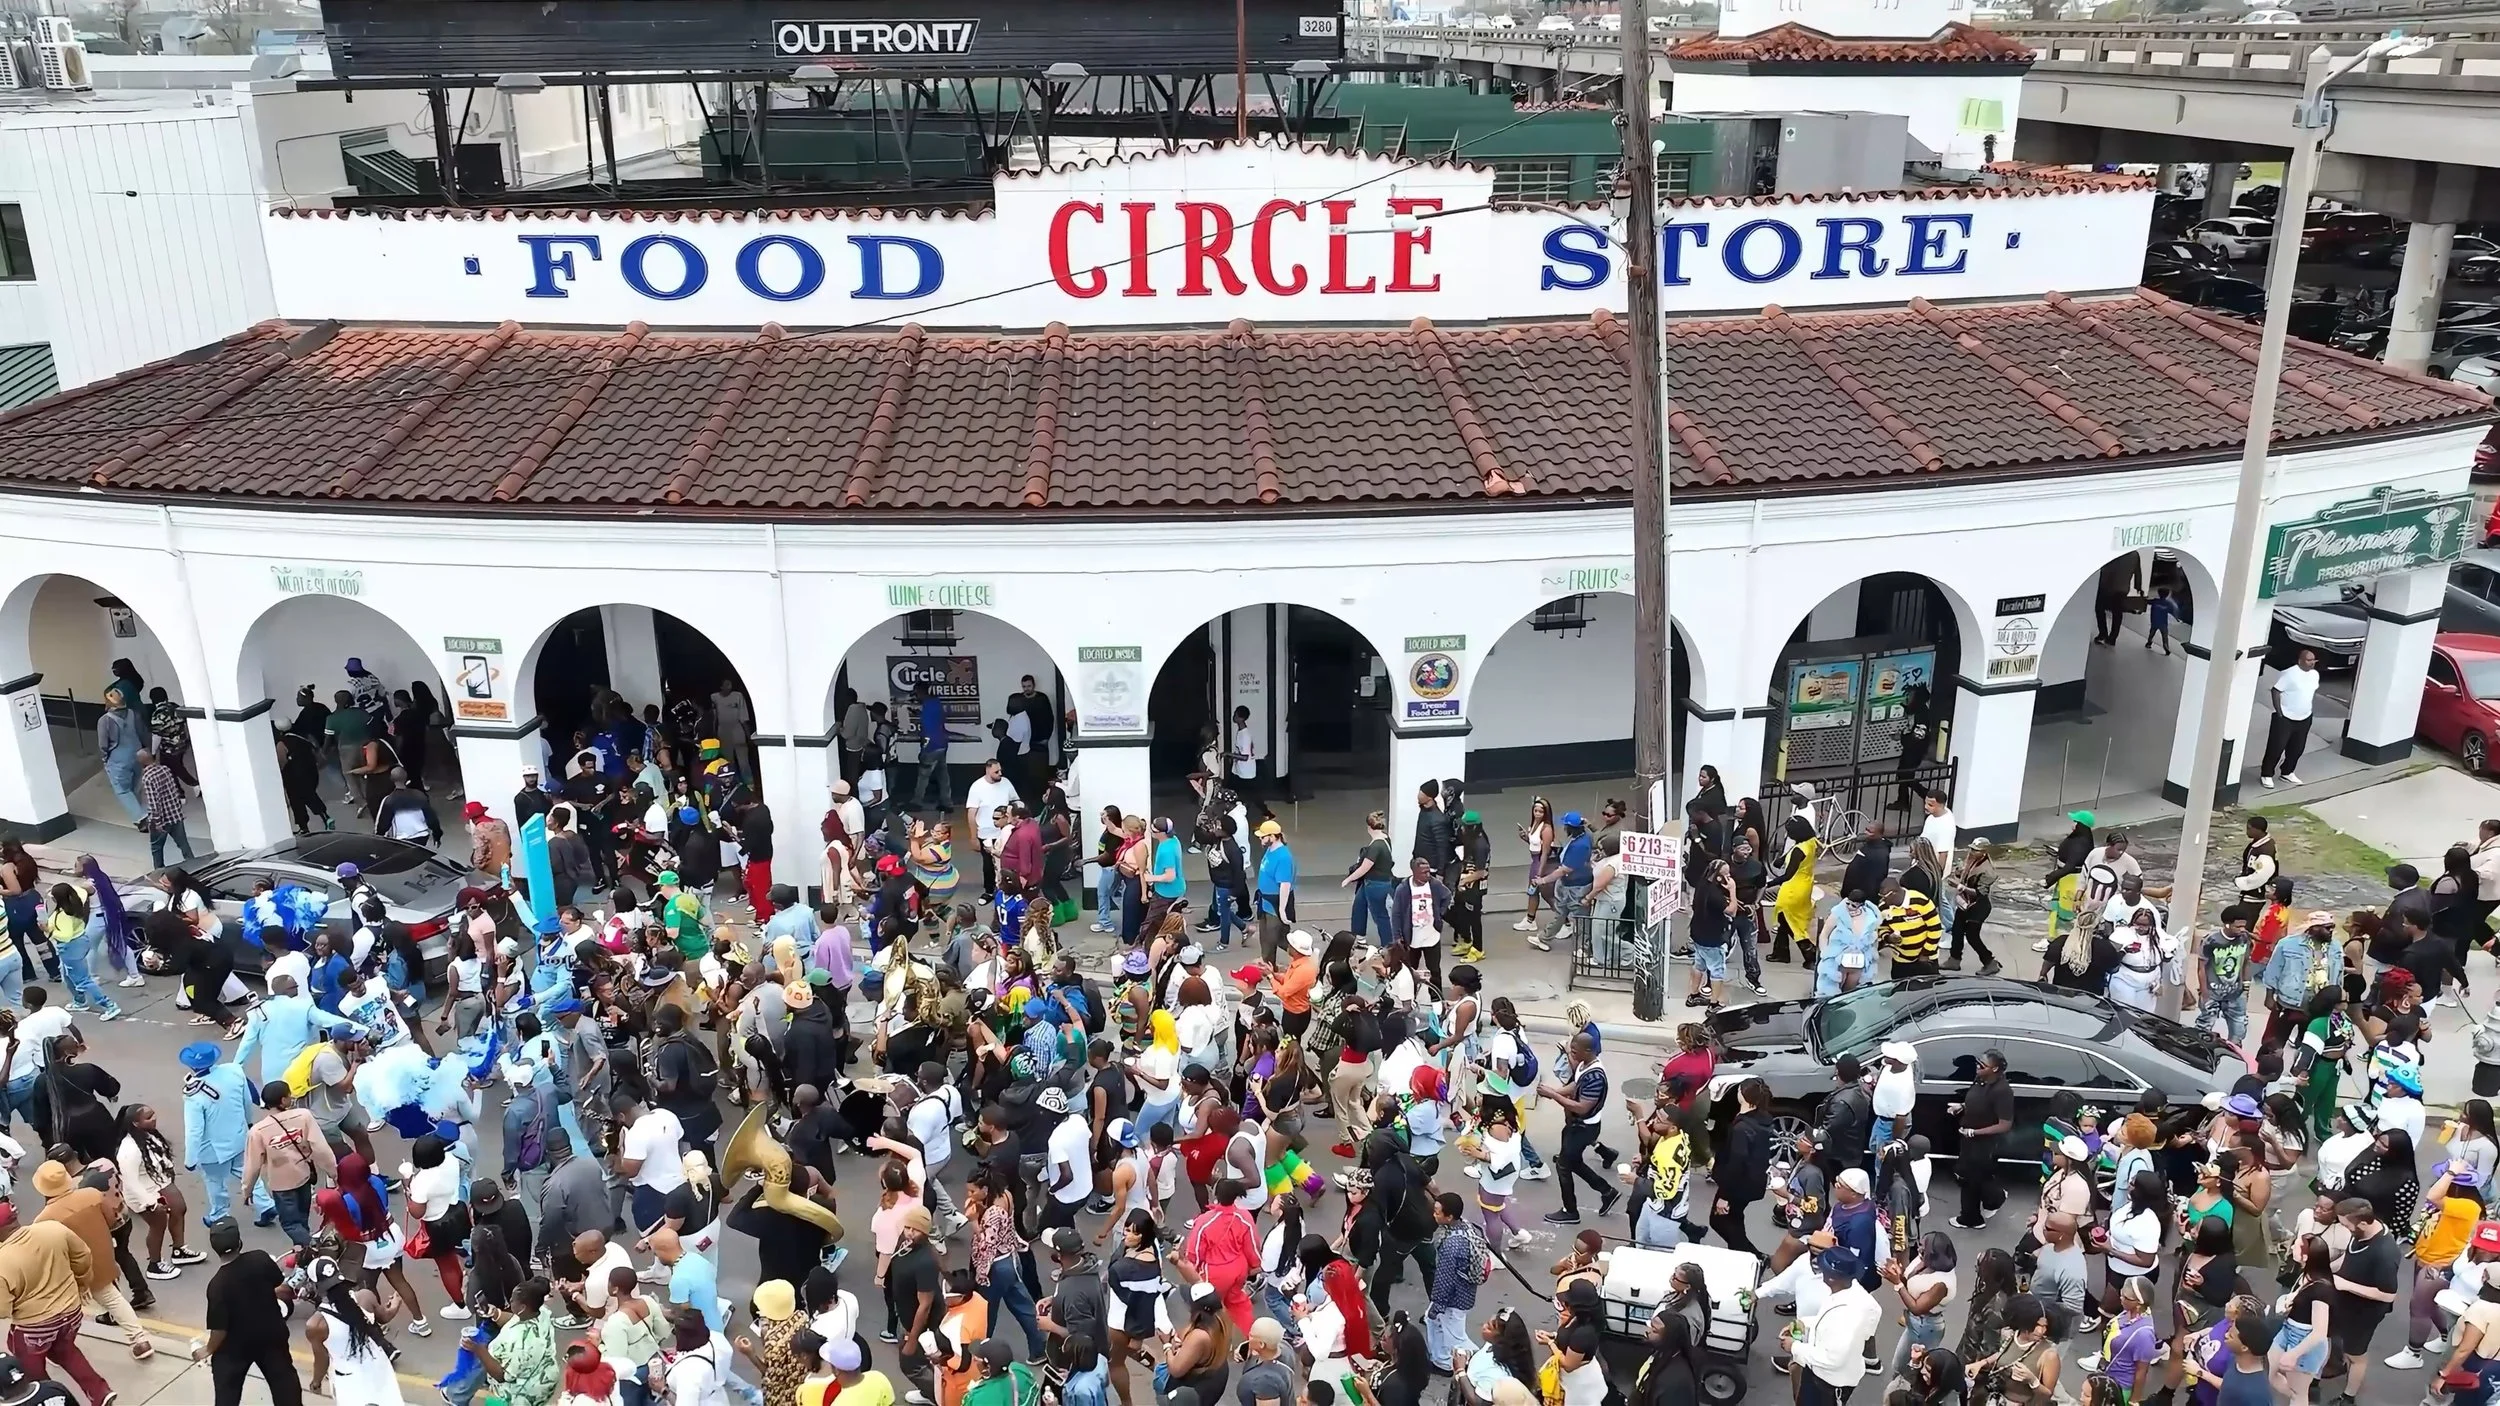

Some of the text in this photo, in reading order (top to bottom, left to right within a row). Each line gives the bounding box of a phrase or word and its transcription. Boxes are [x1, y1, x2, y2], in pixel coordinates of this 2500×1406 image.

[1304, 20, 1332, 32] 3280
[517, 198, 1974, 300] FOOD CIRCLE STORE
[2121, 522, 2184, 547] VEGETABLES
[2285, 524, 2420, 586] Pharmacy
[277, 575, 304, 593] MEAT
[314, 577, 360, 596] SEAFOOD
[1568, 568, 1619, 591] FRUITS
[887, 584, 993, 606] WINE & CHEESE
[1409, 636, 1461, 650] LOCATED INSIDE
[1083, 648, 1136, 660] LOCATED INSIDE
[891, 661, 945, 691] Circle
[1990, 657, 2035, 676] GIFT SHOP
[1411, 708, 1456, 717] Food Court
[1420, 702, 1447, 711] Tremé
[1622, 864, 1676, 878] 504-322-7928
[997, 905, 1008, 926] 17
